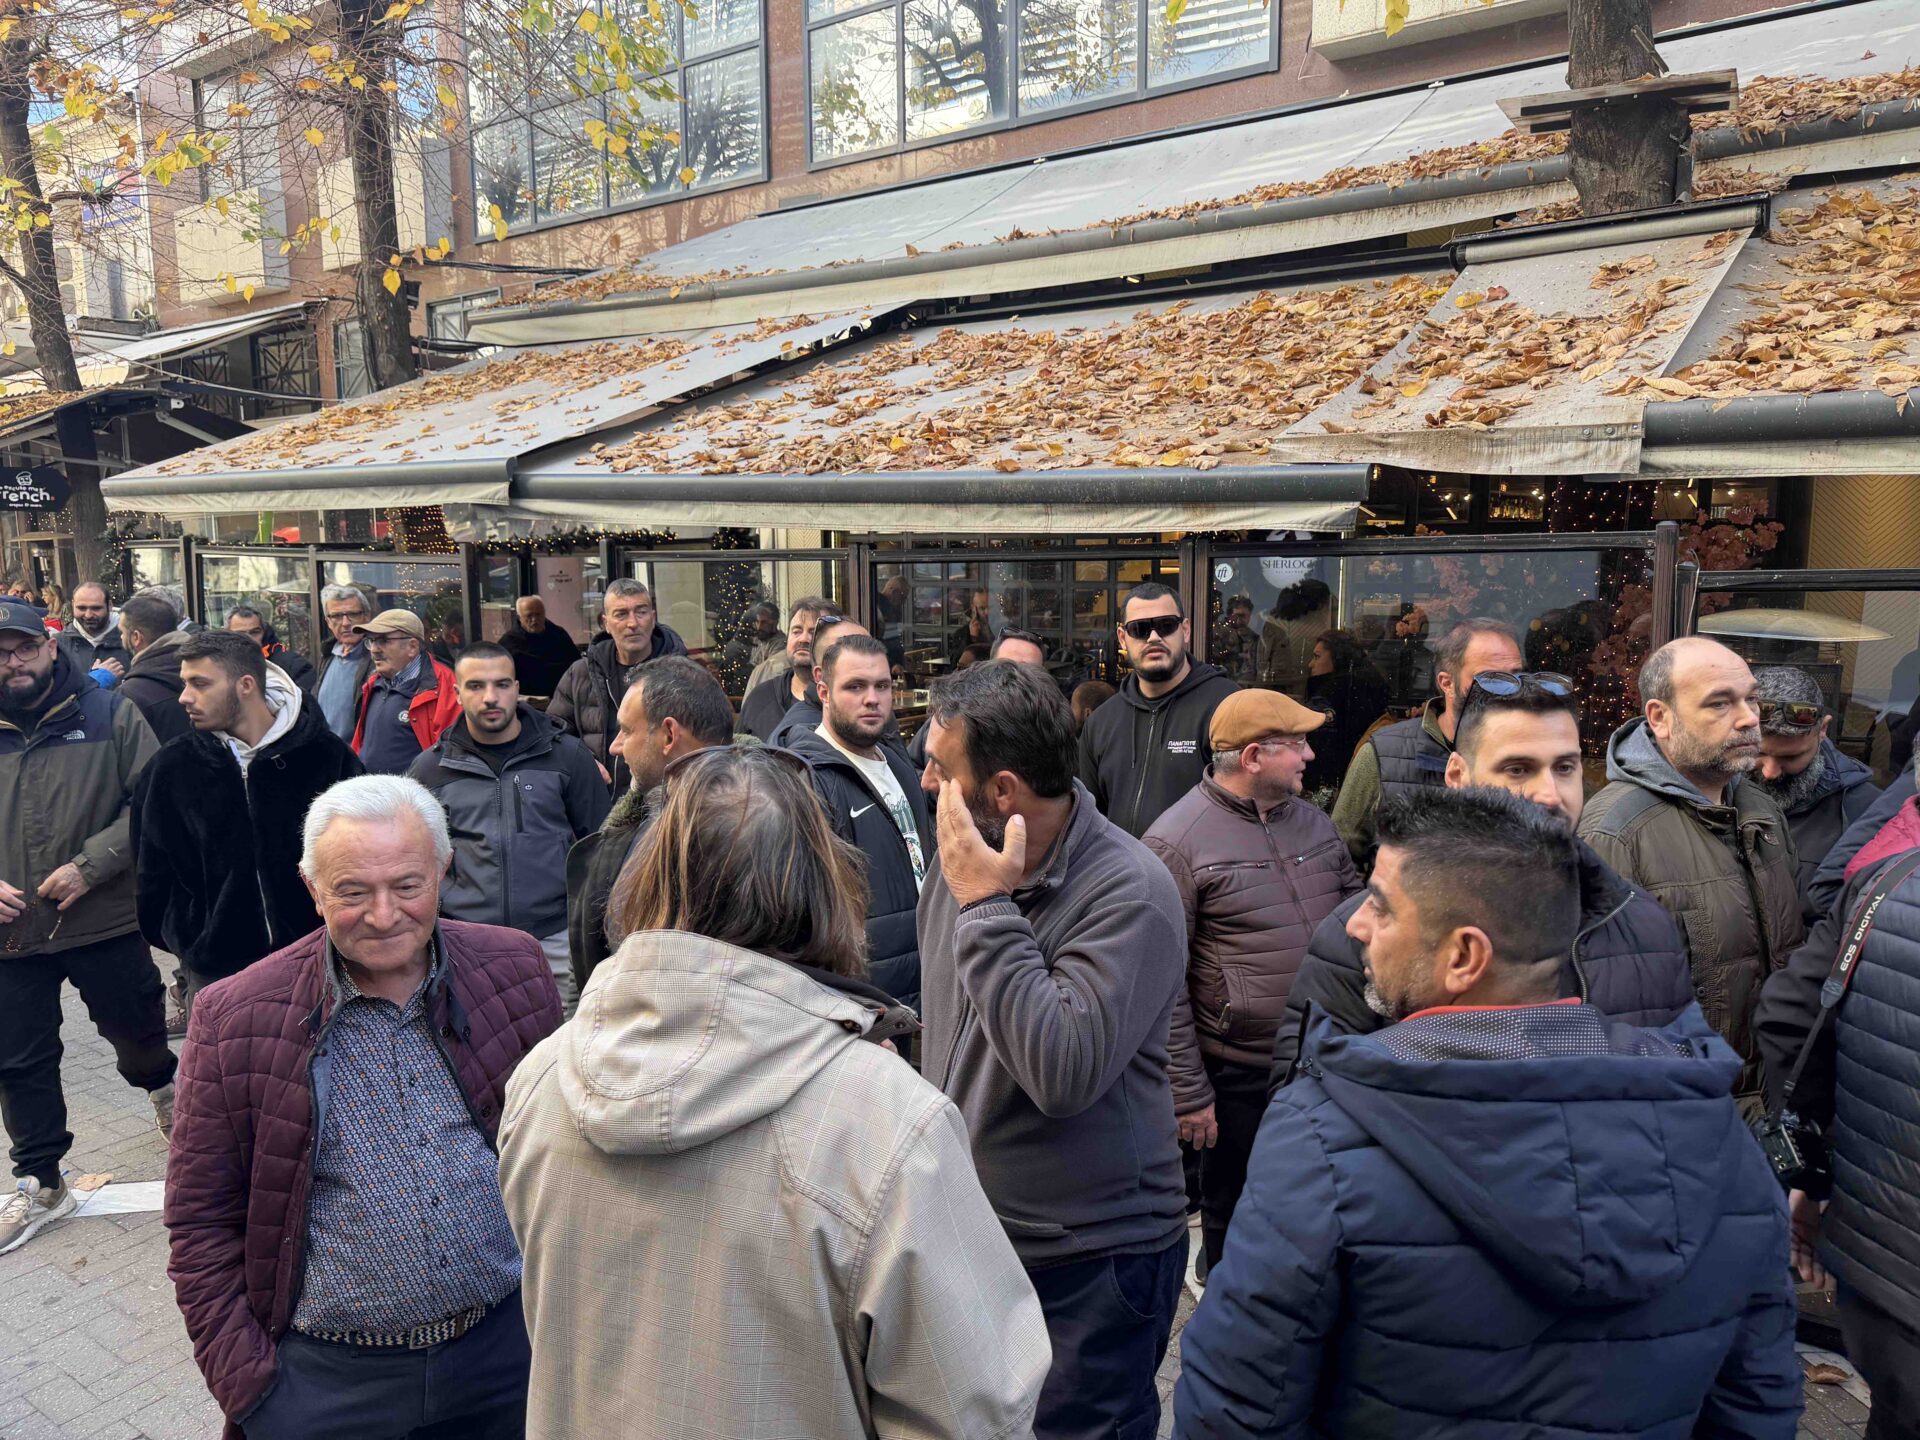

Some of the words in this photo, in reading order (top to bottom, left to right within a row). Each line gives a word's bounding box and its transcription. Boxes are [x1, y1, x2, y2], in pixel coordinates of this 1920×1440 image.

[0, 488, 55, 502] rench.
[1839, 944, 1857, 972] EOS
[1854, 892, 1886, 941] DIGITAL
